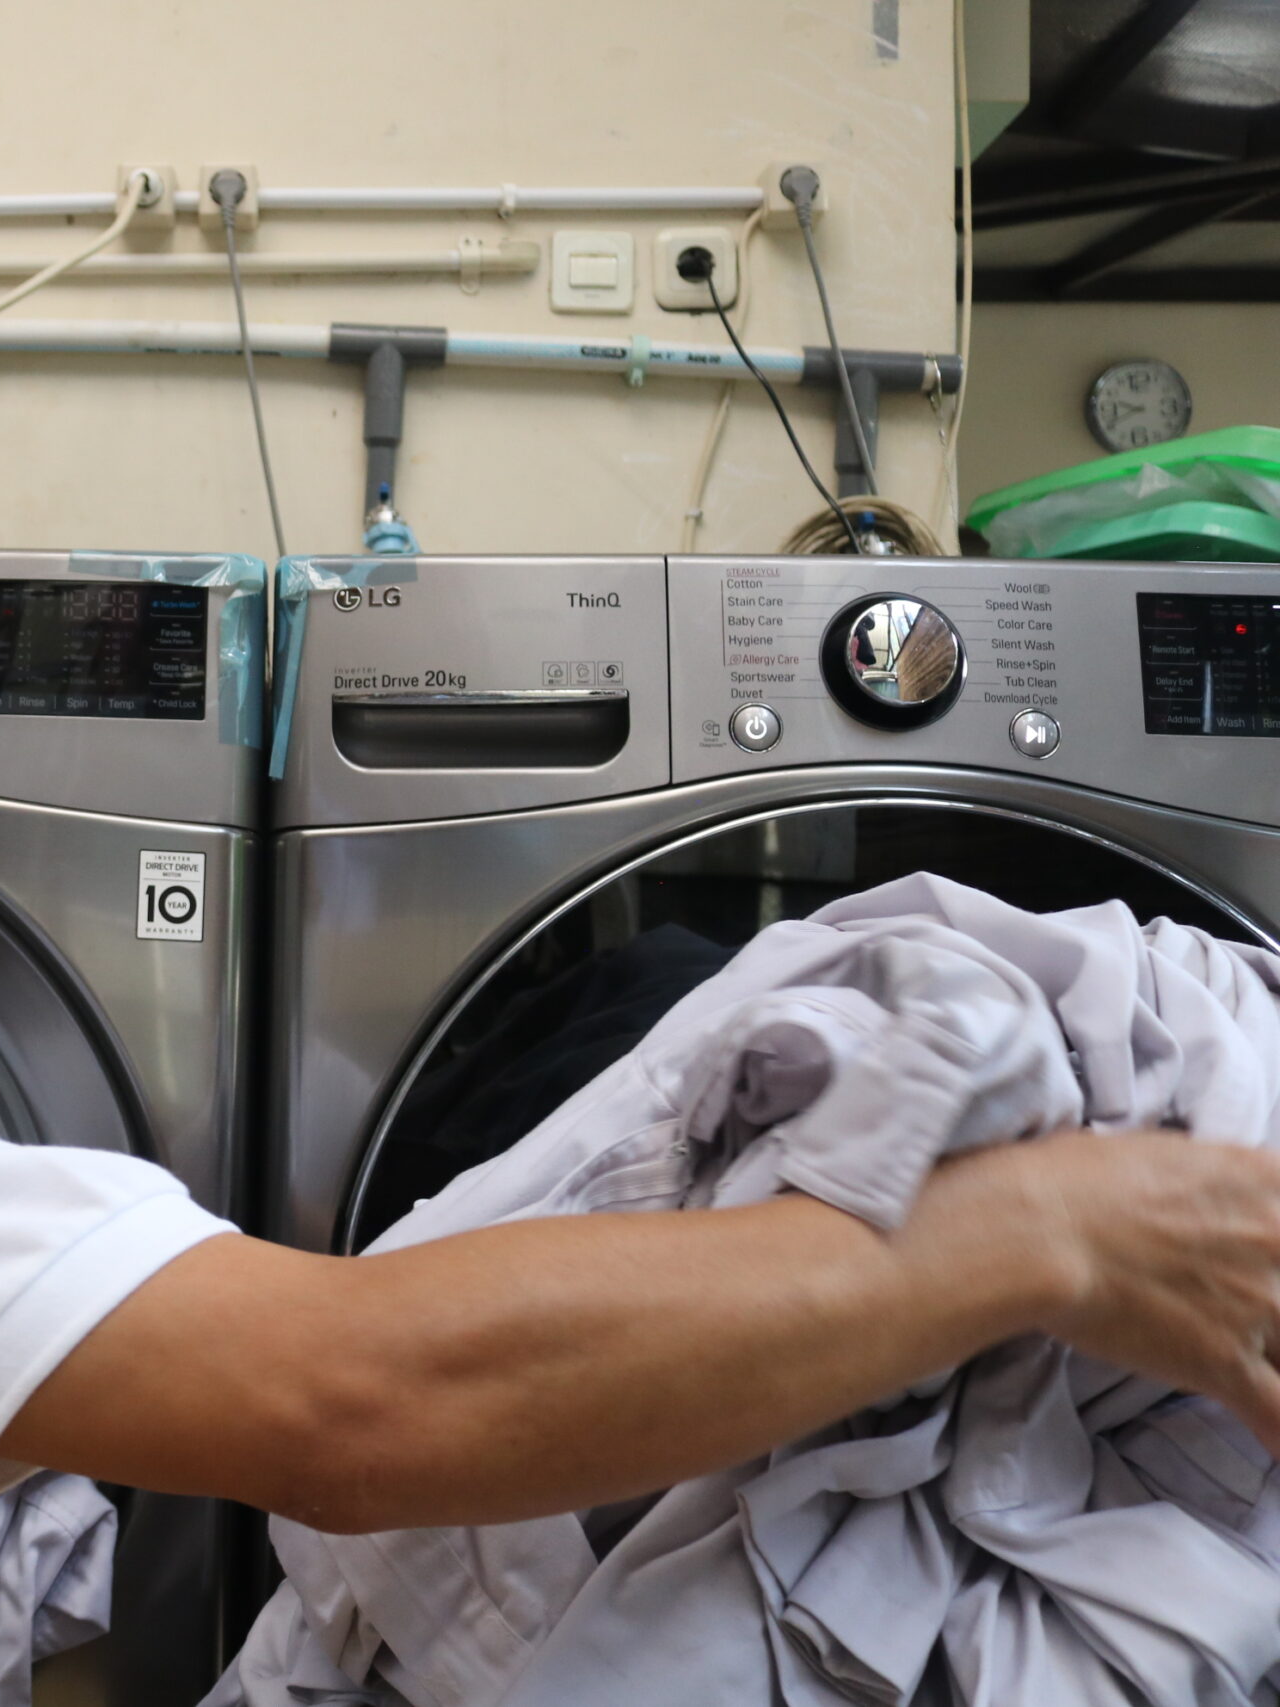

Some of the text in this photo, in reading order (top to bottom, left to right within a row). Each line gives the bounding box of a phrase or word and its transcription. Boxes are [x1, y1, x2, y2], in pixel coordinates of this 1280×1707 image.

[726, 579, 763, 589] Cotton
[1005, 583, 1032, 593] Wool
[368, 587, 401, 607] LG
[566, 592, 621, 608] ThinQ
[728, 597, 783, 607] Stain Care
[985, 599, 1052, 611] Speed Wash
[728, 616, 783, 628] Baby Care
[998, 619, 1053, 631] Color Care
[729, 635, 773, 647] Hygiene
[992, 638, 1055, 651] Silent Wash
[742, 654, 799, 666] Allergy Care
[996, 658, 1056, 672] Rinse+Spin
[335, 676, 377, 688] Direct
[382, 674, 419, 688] Drive
[730, 672, 796, 684] Sportswear
[1005, 676, 1057, 688] Tub Clean
[1155, 677, 1194, 687] Delay End
[731, 688, 763, 699] Duvet
[984, 692, 1058, 706] Download Cycle
[19, 696, 46, 707] Rinse
[66, 697, 89, 710] Spin
[108, 698, 135, 711] Temp
[158, 699, 197, 708] Child Lock
[1167, 715, 1183, 724] Add
[1216, 717, 1246, 728] Wash
[145, 862, 199, 873] DIRECT DRIVE
[145, 884, 197, 924] 10
[145, 927, 194, 935] WARRANTY
